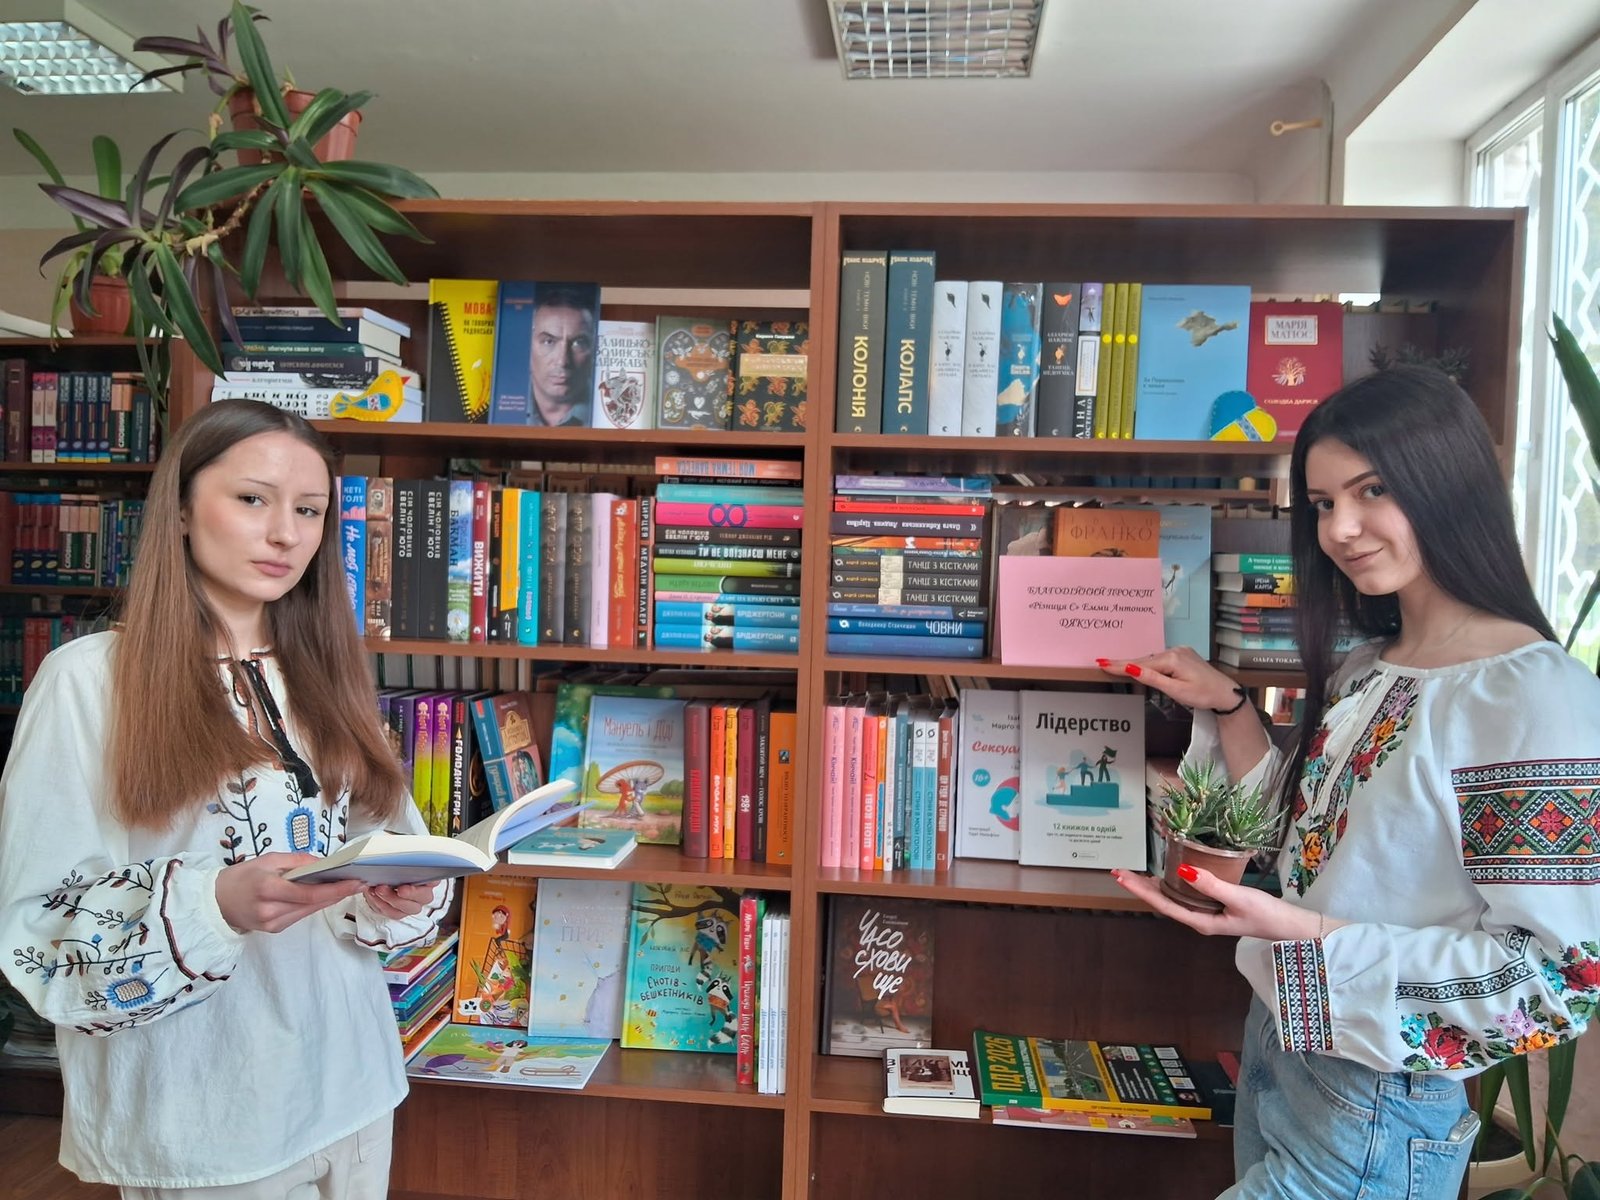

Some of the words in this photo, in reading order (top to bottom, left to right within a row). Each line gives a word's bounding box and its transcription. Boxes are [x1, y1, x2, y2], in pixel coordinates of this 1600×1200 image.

[1271, 329, 1313, 339] МАТІОС
[1275, 319, 1308, 329] МАРІЯ
[851, 335, 869, 418] КОЛОНІЯ
[897, 338, 916, 414] КОЛАПС
[1075, 399, 1086, 439] ЛІНА
[641, 500, 649, 538] ЦИРЦЕЯ
[434, 511, 442, 559] ЧОЛОВІКІВ
[450, 510, 459, 567] БАКМАН
[1070, 526, 1153, 540] ФРАНКО
[698, 547, 710, 557] ТИ
[711, 548, 721, 557] НЕ
[723, 548, 764, 559] ВПІЗНАЄШ
[766, 549, 788, 559] МЕНЕ
[473, 541, 484, 597] ВИЖИТИ
[640, 547, 648, 585] МЕДЛІН
[907, 560, 930, 570] ТАНЦІ
[939, 561, 978, 571] КІСТКАМИ
[907, 576, 930, 586] ТАНЦІ
[939, 577, 978, 587] КІСТКАМИ
[1027, 585, 1106, 598] БЛАГОДІЙНИЙ
[639, 588, 647, 624] МІЛЛЕР
[906, 593, 928, 602] ТАНЦІ
[937, 594, 976, 603] КІСТКАМИ
[1081, 602, 1109, 613] Емми
[925, 620, 963, 635] ЧОВНИ
[1252, 656, 1274, 664] ОЛЬГА
[1275, 657, 1301, 665] ТОКАРЧ
[604, 717, 644, 740] Мануель
[1036, 712, 1131, 735] Лідерство
[972, 740, 1020, 756] Сексуа
[454, 739, 463, 788] ГОЛОДНІ
[453, 790, 462, 816] ІГРИ
[713, 775, 721, 813] ВОЛОДАР
[1052, 822, 1061, 831] 12
[1062, 824, 1090, 832] книжок
[1096, 824, 1117, 834] одній
[650, 963, 681, 973] ПРИГОДИ
[640, 988, 704, 1005] БЕШКЕТНИКІВ
[984, 1035, 1017, 1064] 2026
[989, 1064, 1025, 1092] ПДР
